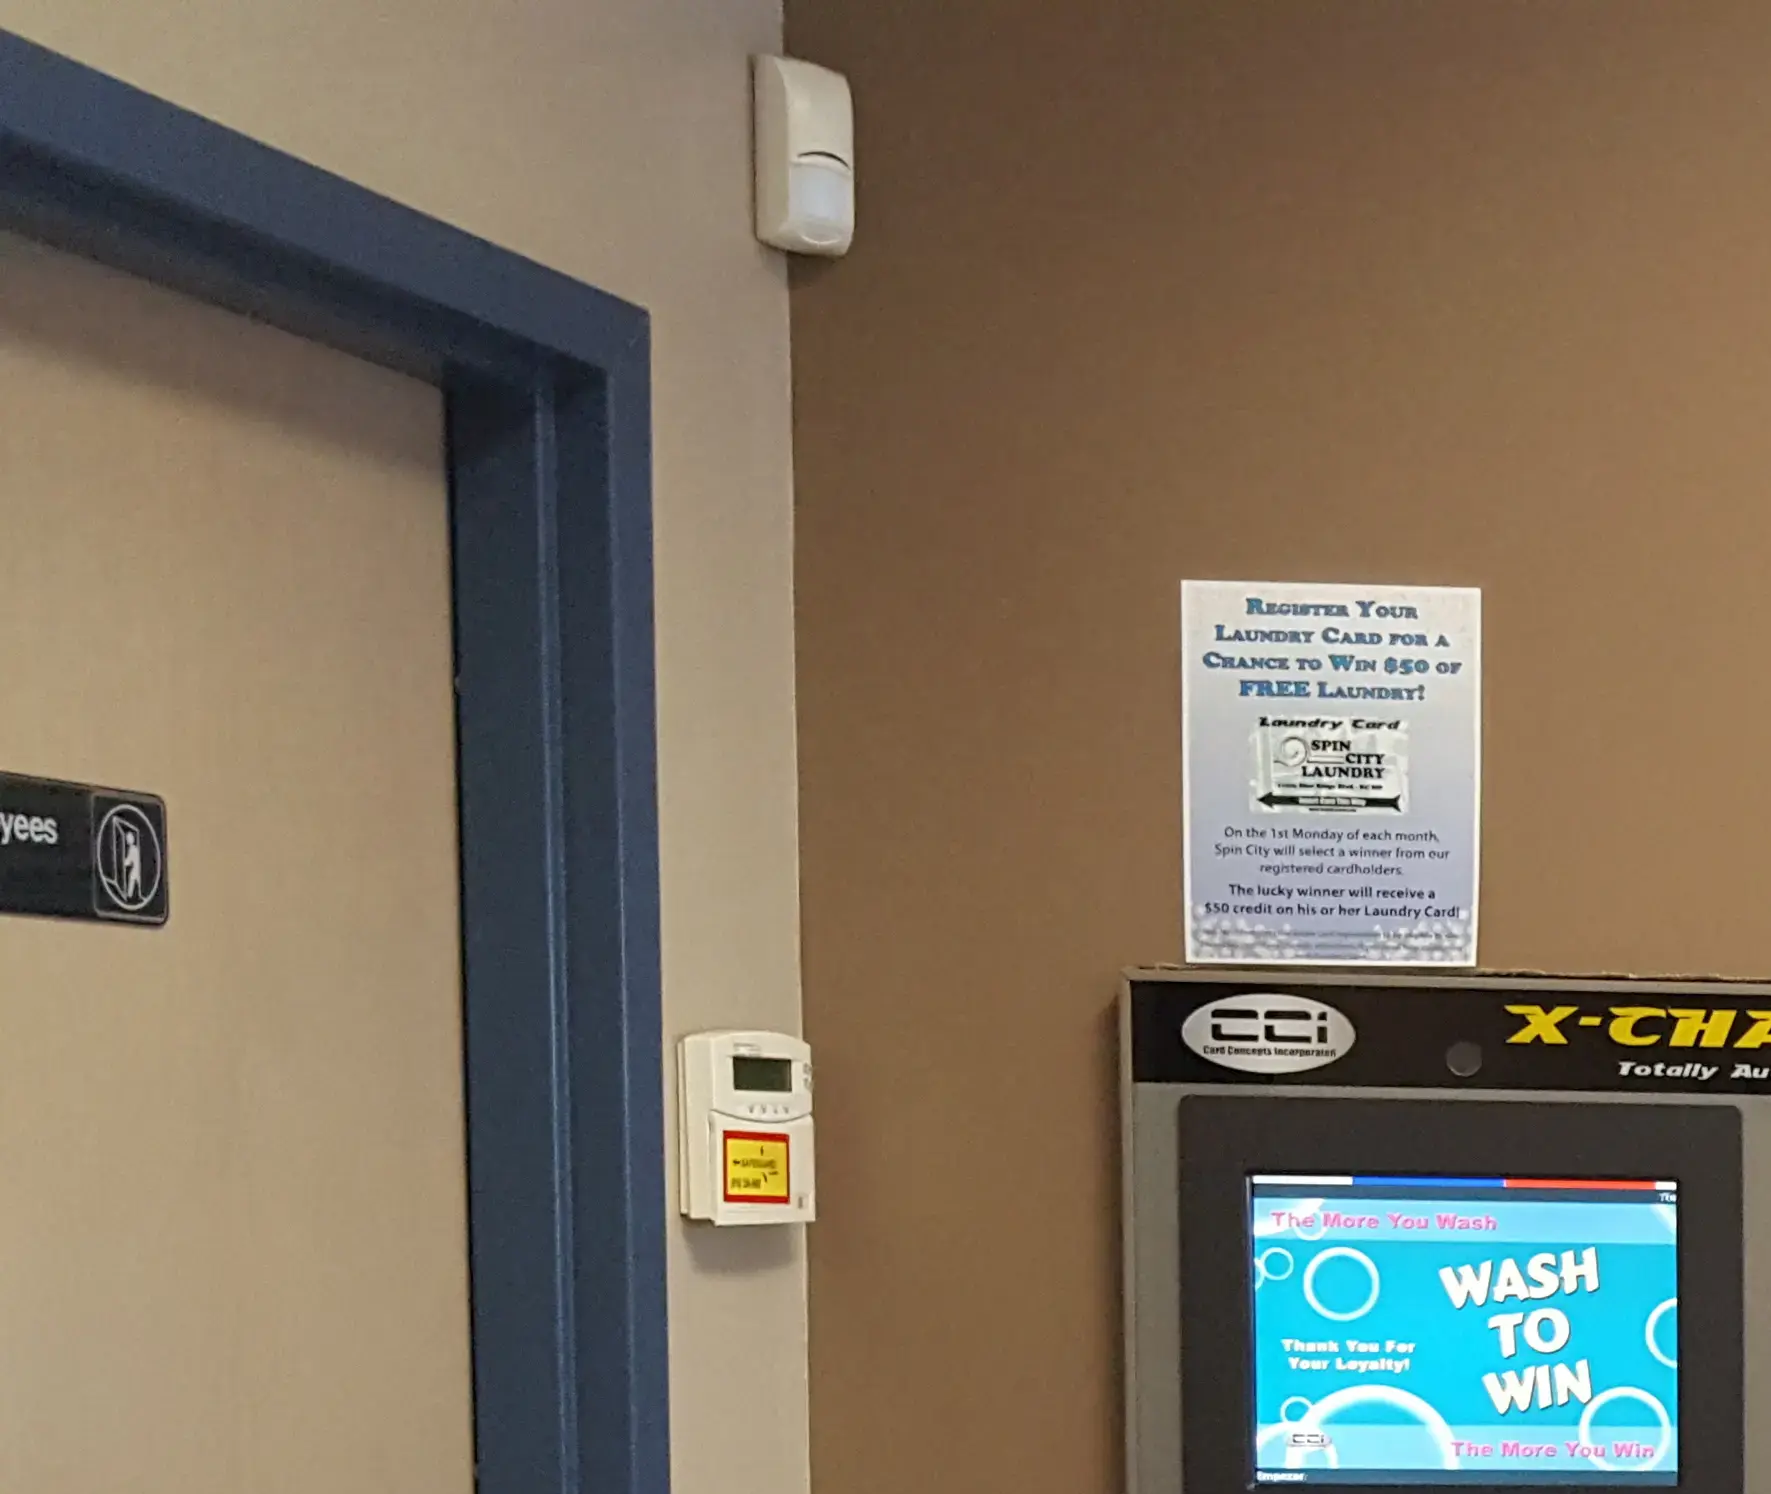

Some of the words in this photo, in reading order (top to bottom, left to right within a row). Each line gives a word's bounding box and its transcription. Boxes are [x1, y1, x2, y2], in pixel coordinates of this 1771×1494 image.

[1239, 680, 1312, 698] FREE
[1203, 1045, 1225, 1055] Card
[1227, 1046, 1272, 1057] Concepts
[1617, 1061, 1718, 1081] Totally
[1270, 1211, 1314, 1228] The
[1322, 1212, 1379, 1228] More
[1387, 1213, 1429, 1229] You
[1435, 1214, 1497, 1231] Wash
[1439, 1246, 1599, 1309] WASH
[1488, 1307, 1570, 1359] TO
[1281, 1339, 1339, 1353] Thank
[1346, 1340, 1379, 1353] You
[1385, 1340, 1416, 1353] For
[1288, 1357, 1330, 1370] Your
[1335, 1358, 1410, 1373] Loyalty!
[1481, 1358, 1593, 1416] WIN
[1451, 1442, 1493, 1457] The
[1501, 1442, 1557, 1458] More
[1565, 1442, 1606, 1458] You
[1614, 1443, 1654, 1458] Win
